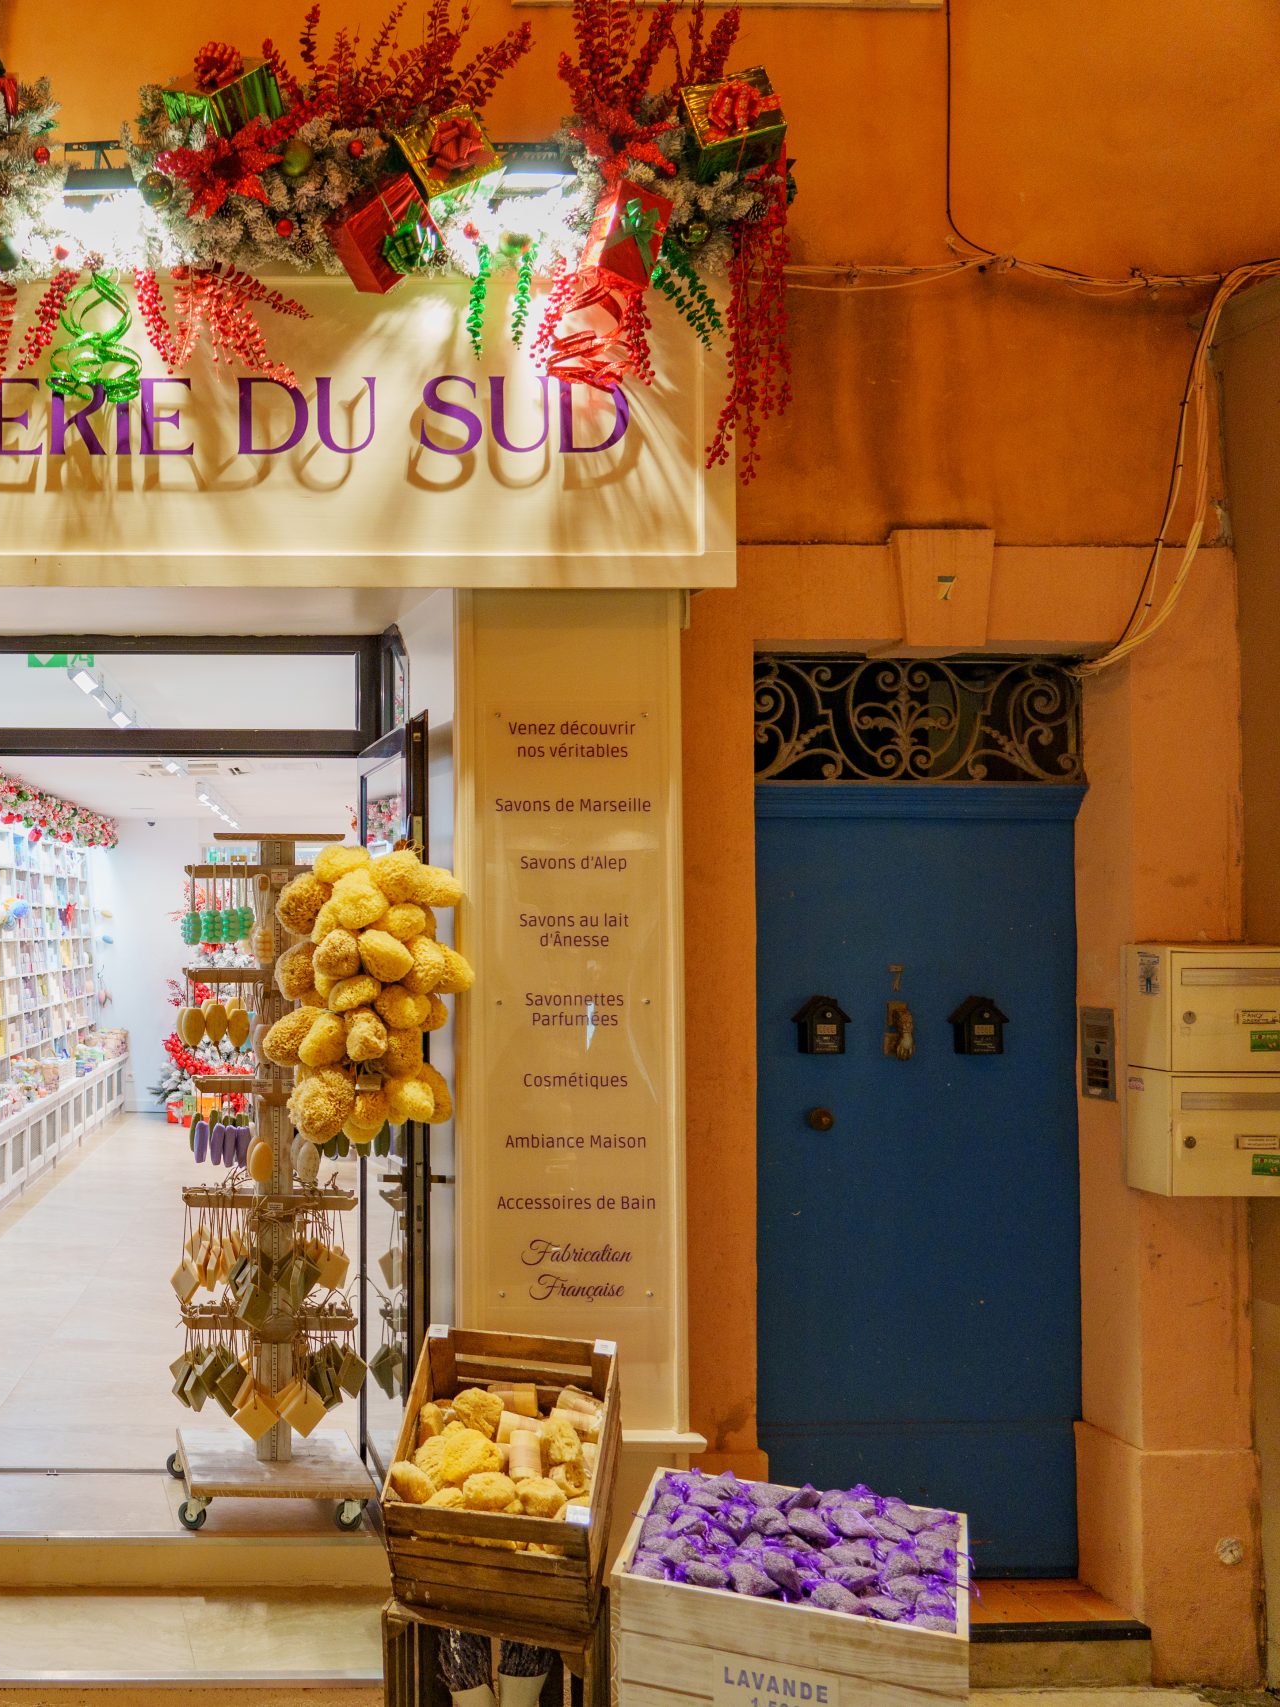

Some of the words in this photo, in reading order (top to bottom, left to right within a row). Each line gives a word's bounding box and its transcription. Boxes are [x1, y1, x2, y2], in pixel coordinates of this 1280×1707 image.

[236, 376, 378, 455] DU
[420, 375, 630, 455] SUD
[937, 575, 956, 601] 7
[508, 721, 556, 736] Venez
[560, 720, 636, 736] découvrir
[517, 745, 545, 758] nos
[549, 743, 628, 758] véritables
[495, 798, 551, 812] Savons
[555, 798, 575, 812] de
[579, 798, 652, 812] Marseille
[520, 856, 576, 870] Savons
[580, 855, 627, 873] d'Alep
[519, 914, 575, 928] Savons
[579, 915, 599, 928] au
[603, 913, 629, 928] lait
[540, 930, 610, 947] d'Ânesse
[525, 992, 625, 1007] Savonnettes
[532, 1011, 619, 1027] Parfumées
[523, 1072, 628, 1090] Cosmétiques
[505, 1134, 585, 1149] Ambiance
[590, 1135, 647, 1149] Maison
[497, 1195, 592, 1210] Accessoires
[596, 1195, 616, 1210] de
[621, 1195, 656, 1210] Bain
[521, 1239, 632, 1266] Fabrication
[529, 1273, 625, 1303] Française
[724, 1665, 828, 1704] LAVANDE
